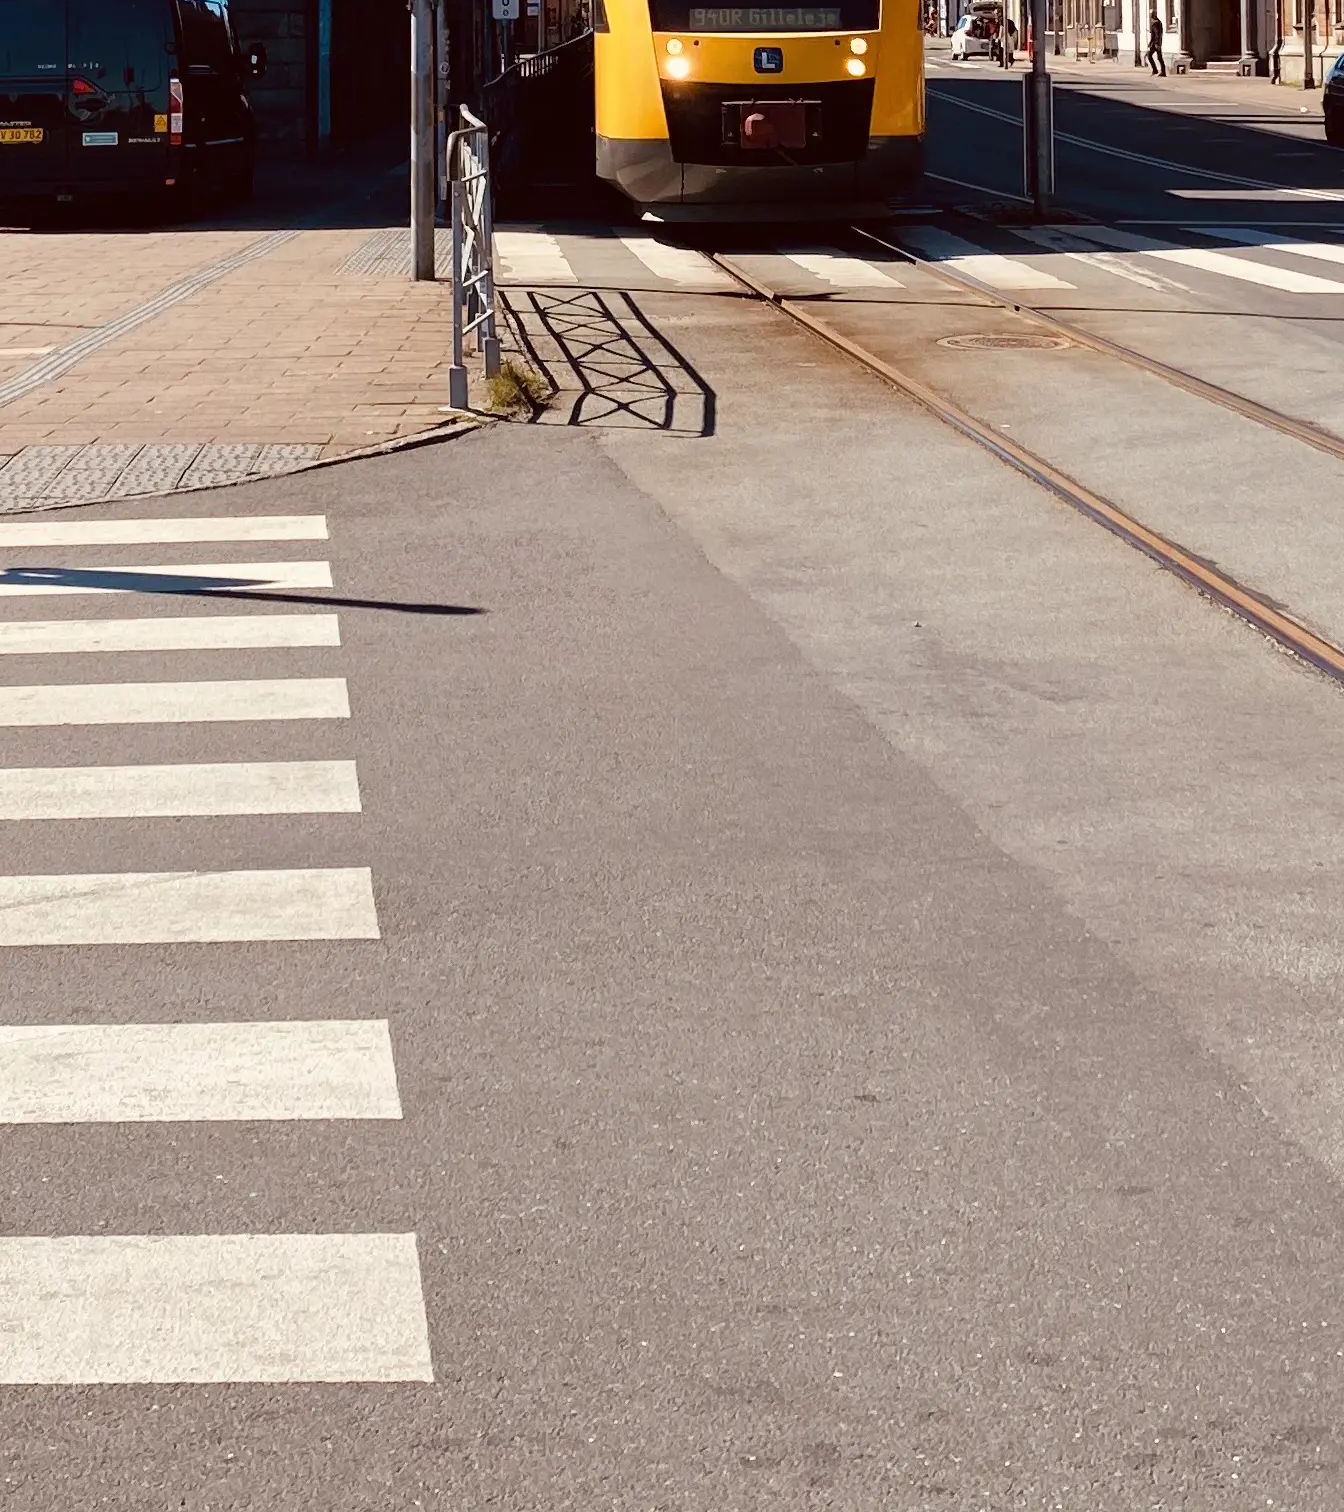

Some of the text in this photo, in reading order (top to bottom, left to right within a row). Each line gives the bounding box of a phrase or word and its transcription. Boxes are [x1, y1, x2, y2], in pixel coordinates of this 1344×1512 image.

[748, 8, 836, 27] Gilleleje
[761, 51, 776, 69] L
[8, 129, 22, 140] 30
